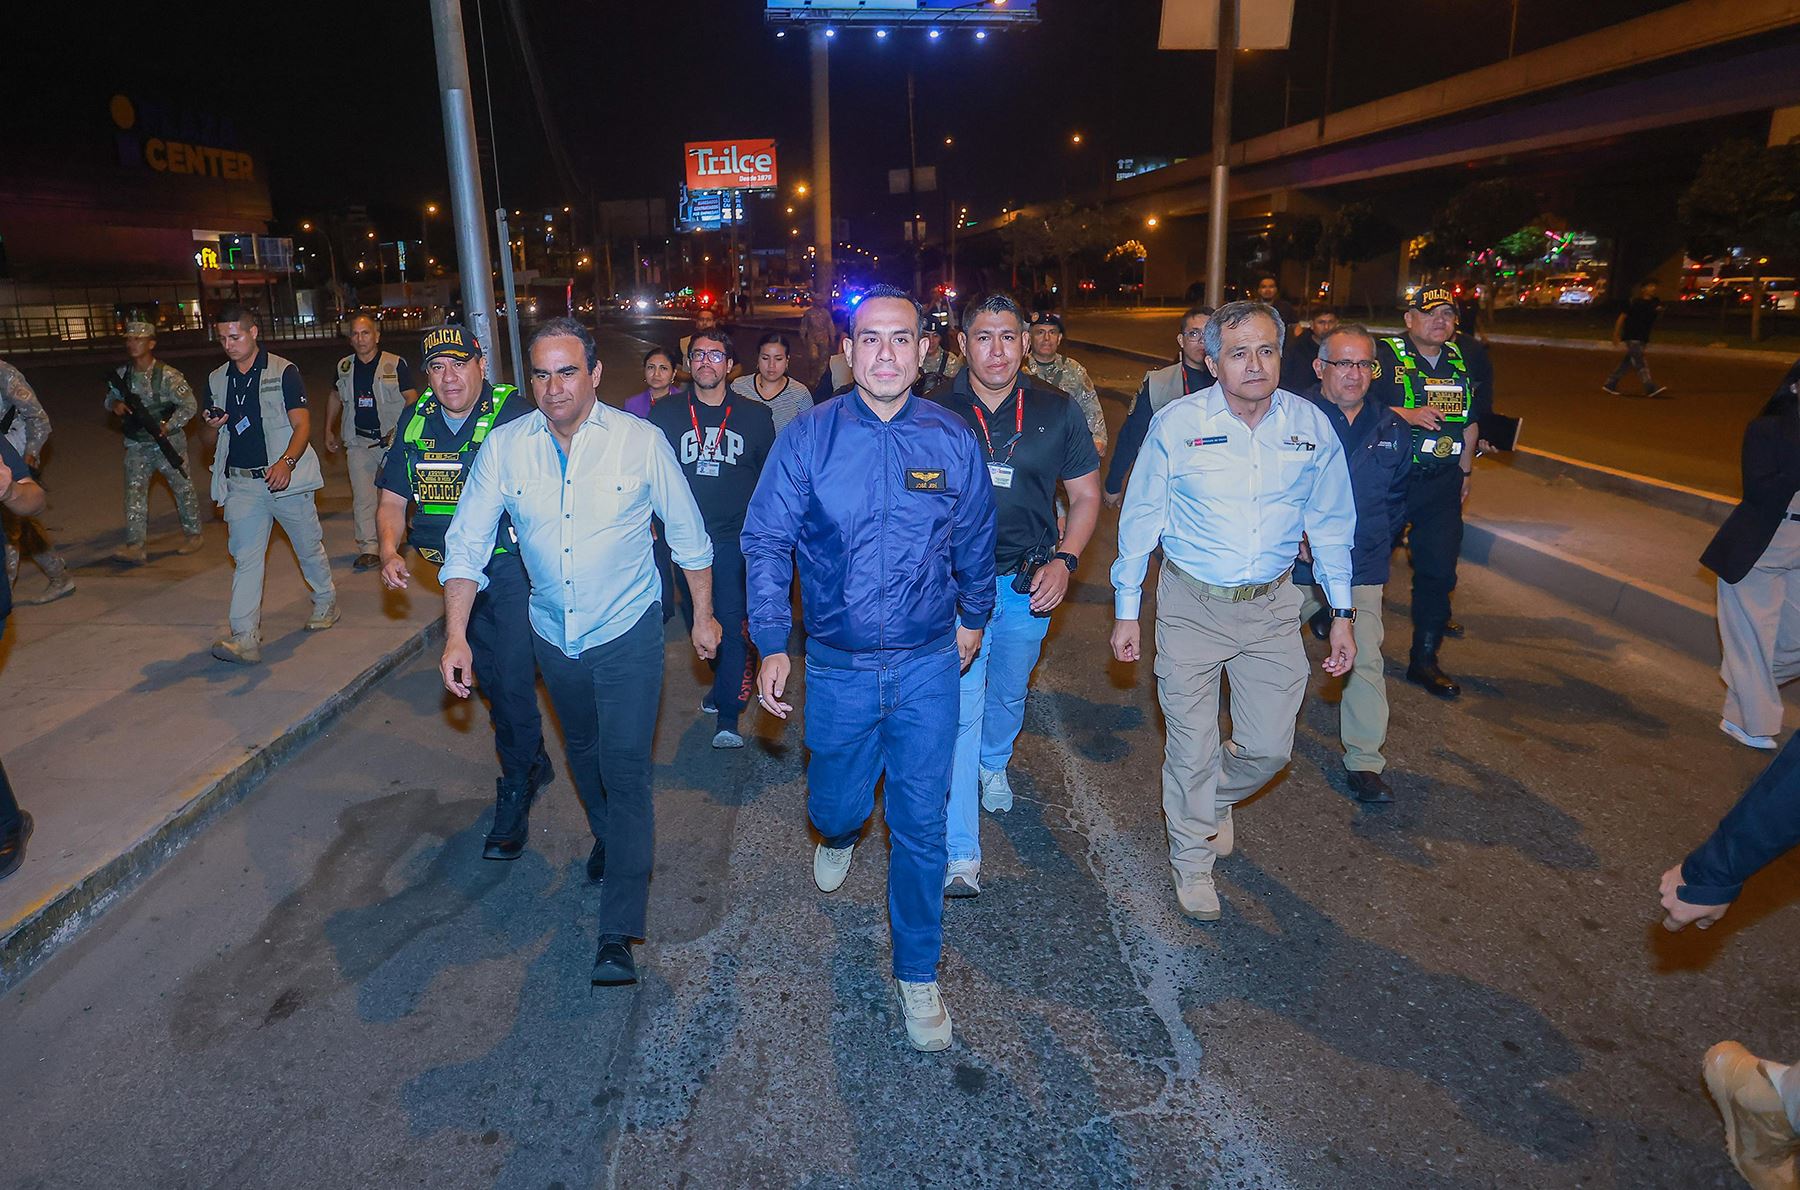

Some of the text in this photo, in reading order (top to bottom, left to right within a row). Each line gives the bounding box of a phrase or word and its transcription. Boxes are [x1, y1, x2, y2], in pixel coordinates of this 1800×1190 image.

[146, 138, 255, 181] CENTER
[689, 146, 772, 176] Trilce
[424, 329, 464, 355] POLICIA
[680, 426, 744, 466] GAP
[420, 484, 461, 501] POLICIA
